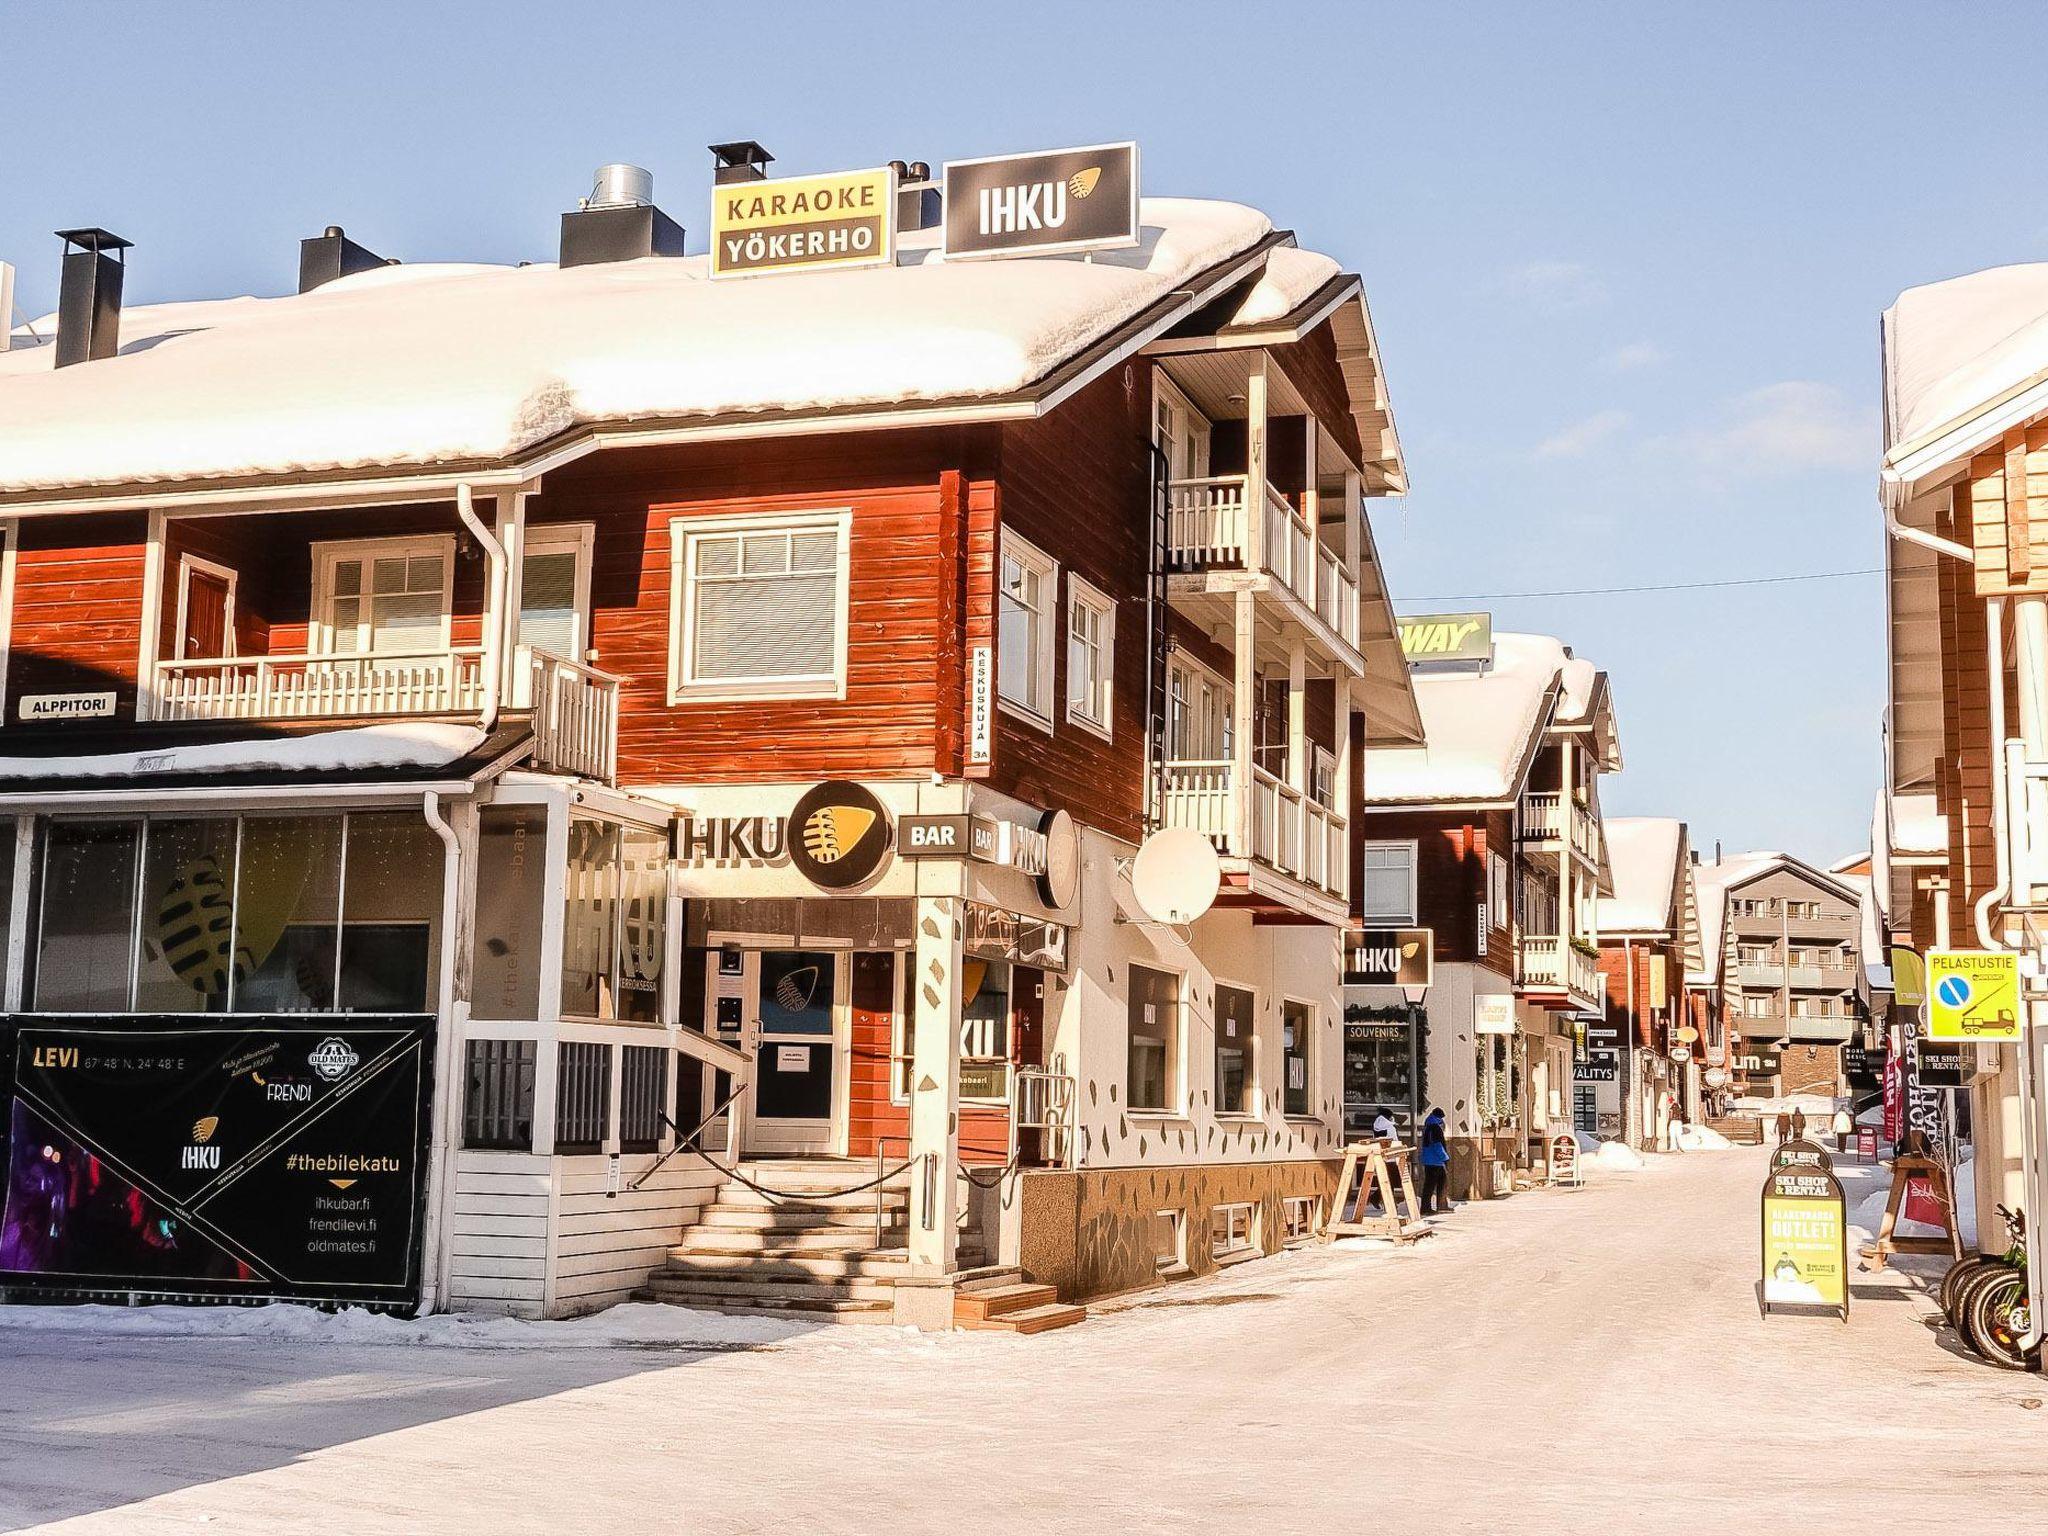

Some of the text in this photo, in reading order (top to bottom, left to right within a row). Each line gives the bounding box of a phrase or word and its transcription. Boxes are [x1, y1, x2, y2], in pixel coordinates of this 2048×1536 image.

[728, 184, 875, 221] KARAOKE
[979, 180, 1067, 235] IHKU
[725, 225, 873, 263] YÖKERHO
[1397, 619, 1481, 654] WAY
[976, 650, 986, 740] KESKUSKUJA
[32, 698, 107, 713] ALPPITORI
[973, 751, 988, 759] 3A
[667, 816, 789, 860] IHKU
[911, 825, 956, 846] BAR
[975, 827, 993, 851] BAR
[1355, 947, 1402, 973] IHKU
[1932, 957, 2013, 969] PELASTUSTIE
[1350, 1027, 1400, 1038] SOUVENIRS
[33, 1047, 79, 1068] LEVI
[177, 1059, 184, 1070] E
[312, 1055, 357, 1063] OLD MATES
[1925, 1055, 1940, 1063] SKI
[267, 1083, 312, 1101] FRENDI
[181, 1146, 221, 1170] IHKU
[286, 1154, 400, 1172] #thebilekatu
[1775, 1175, 1829, 1188] SKI SHOP
[1785, 1186, 1830, 1197] RENTAL
[315, 1197, 370, 1212] ihkubar.fi
[309, 1217, 377, 1232] frendilevi.fi
[1772, 1221, 1836, 1240] OUTLET!
[307, 1240, 377, 1253] oldmates.fi
